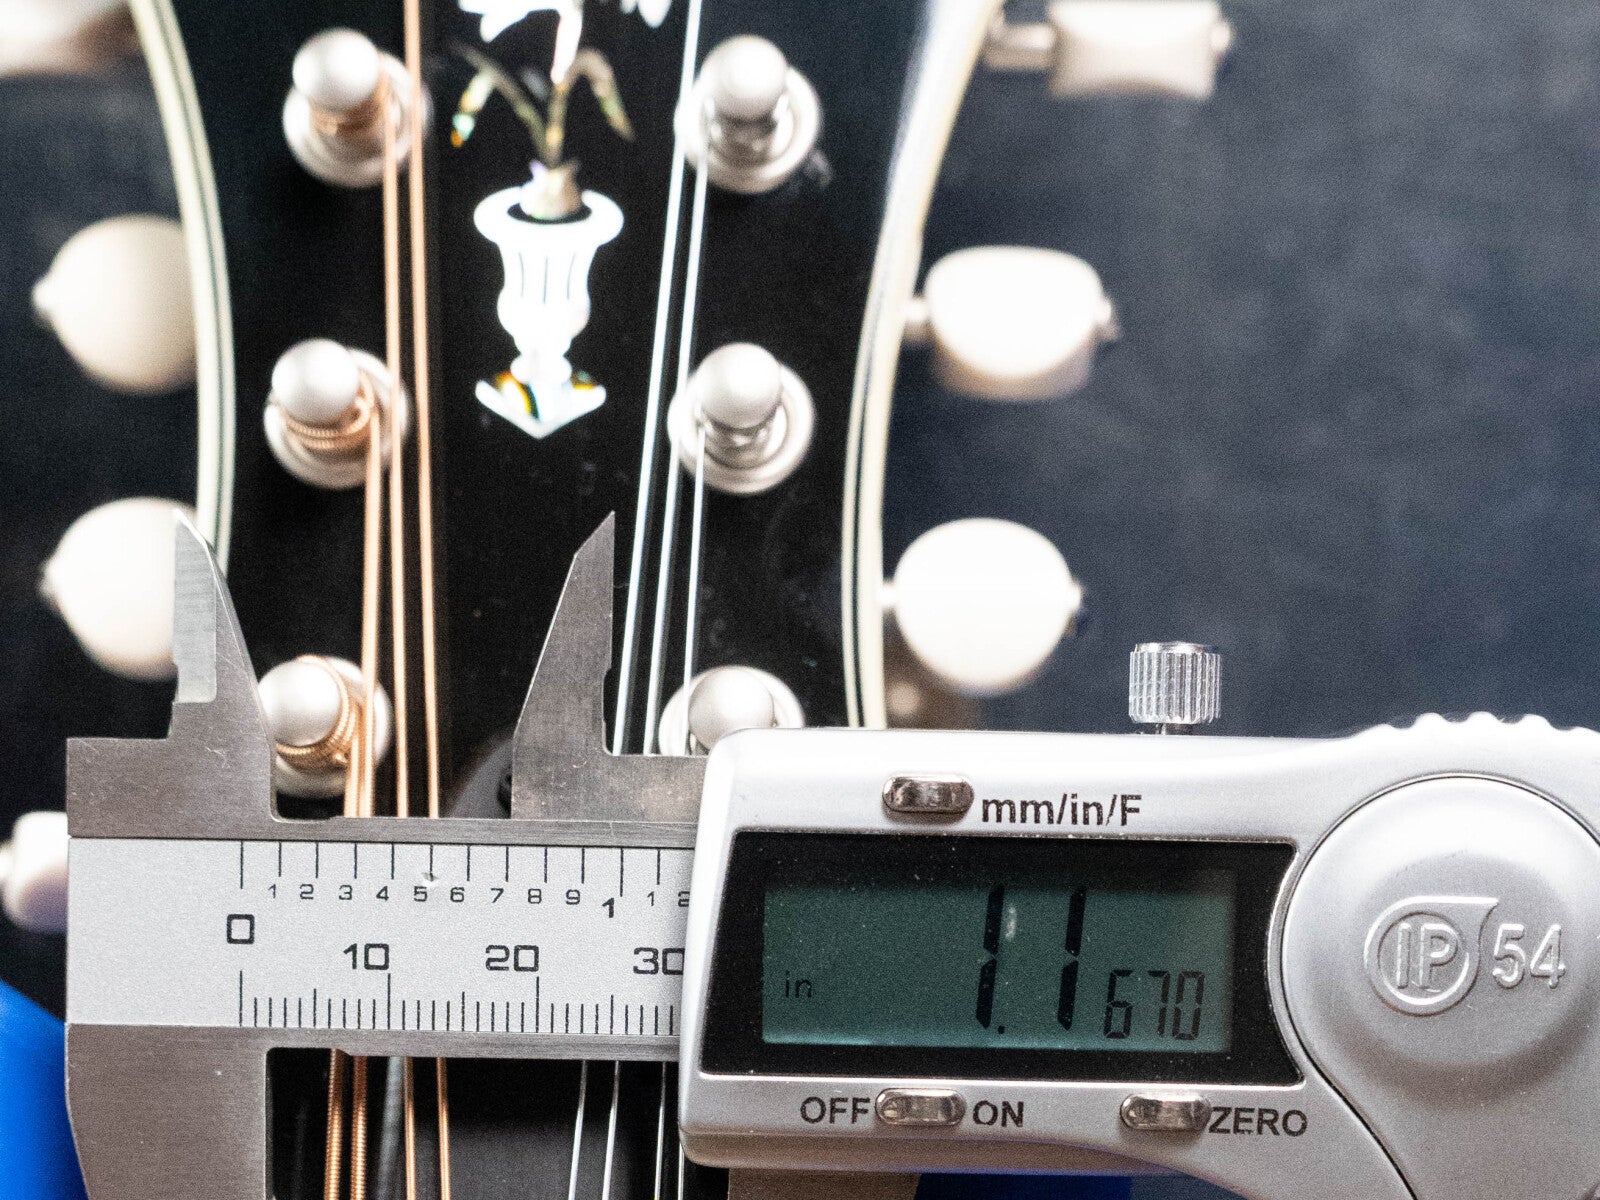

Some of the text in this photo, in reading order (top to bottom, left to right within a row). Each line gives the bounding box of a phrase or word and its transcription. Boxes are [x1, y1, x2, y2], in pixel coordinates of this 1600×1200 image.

[981, 793, 1142, 827] mm/in/F
[268, 884, 277, 899] 1
[299, 883, 315, 900] 2
[338, 884, 353, 901] 3
[375, 885, 390, 901] 4
[413, 886, 428, 902] 5
[450, 886, 465, 903] 6
[490, 887, 505, 904] 7
[527, 887, 542, 905] 8
[565, 888, 580, 905] 9
[601, 897, 615, 918] 1
[646, 890, 655, 907] 1
[226, 913, 256, 945] 0
[343, 942, 685, 975] 10 20 30
[1396, 922, 1567, 990] IP 54
[783, 969, 813, 999] in
[800, 1096, 871, 1125] OFF
[972, 1100, 1025, 1128] ON
[1208, 1106, 1308, 1137] ZERO
